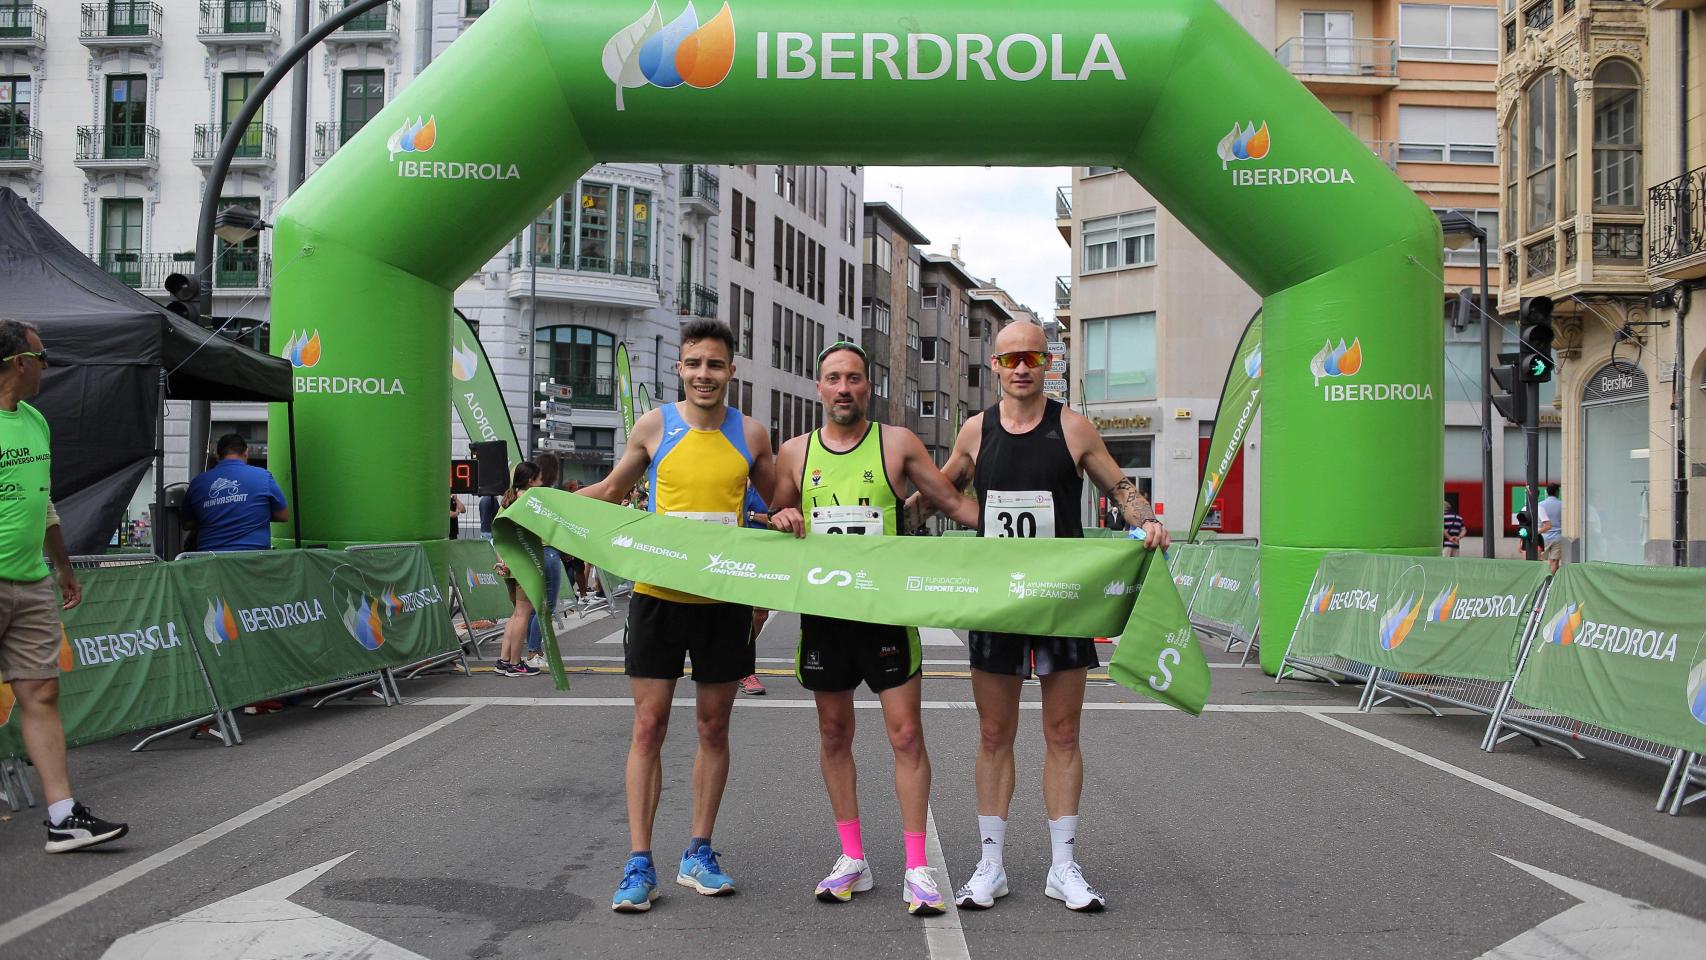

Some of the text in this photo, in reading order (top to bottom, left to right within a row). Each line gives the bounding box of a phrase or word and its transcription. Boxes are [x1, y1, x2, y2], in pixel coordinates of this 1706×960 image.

[756, 31, 1127, 81] IBERDROLA
[398, 160, 520, 180] IBERDROLA
[1232, 167, 1355, 186] IBERDROLA
[294, 376, 405, 395] BERDROLA
[1324, 383, 1433, 401] IBERDROLA
[1602, 373, 1633, 392] Bershka
[1219, 389, 1259, 474] IBERDROLA
[0, 456, 35, 468] UNIVERSO
[997, 511, 1037, 538] 30
[633, 541, 688, 560] IBERDROLA
[710, 566, 791, 581] UNIVERSO MUJER
[719, 559, 755, 571] TOUR
[924, 584, 953, 592] DEPORTE
[1025, 588, 1080, 600] DE ZAMORA
[1026, 581, 1081, 591] AYUNTAMIENTO
[238, 598, 327, 632] IBERDROLA
[74, 622, 182, 666] IBERDROLA
[1573, 619, 1678, 662] IBERDROLA
